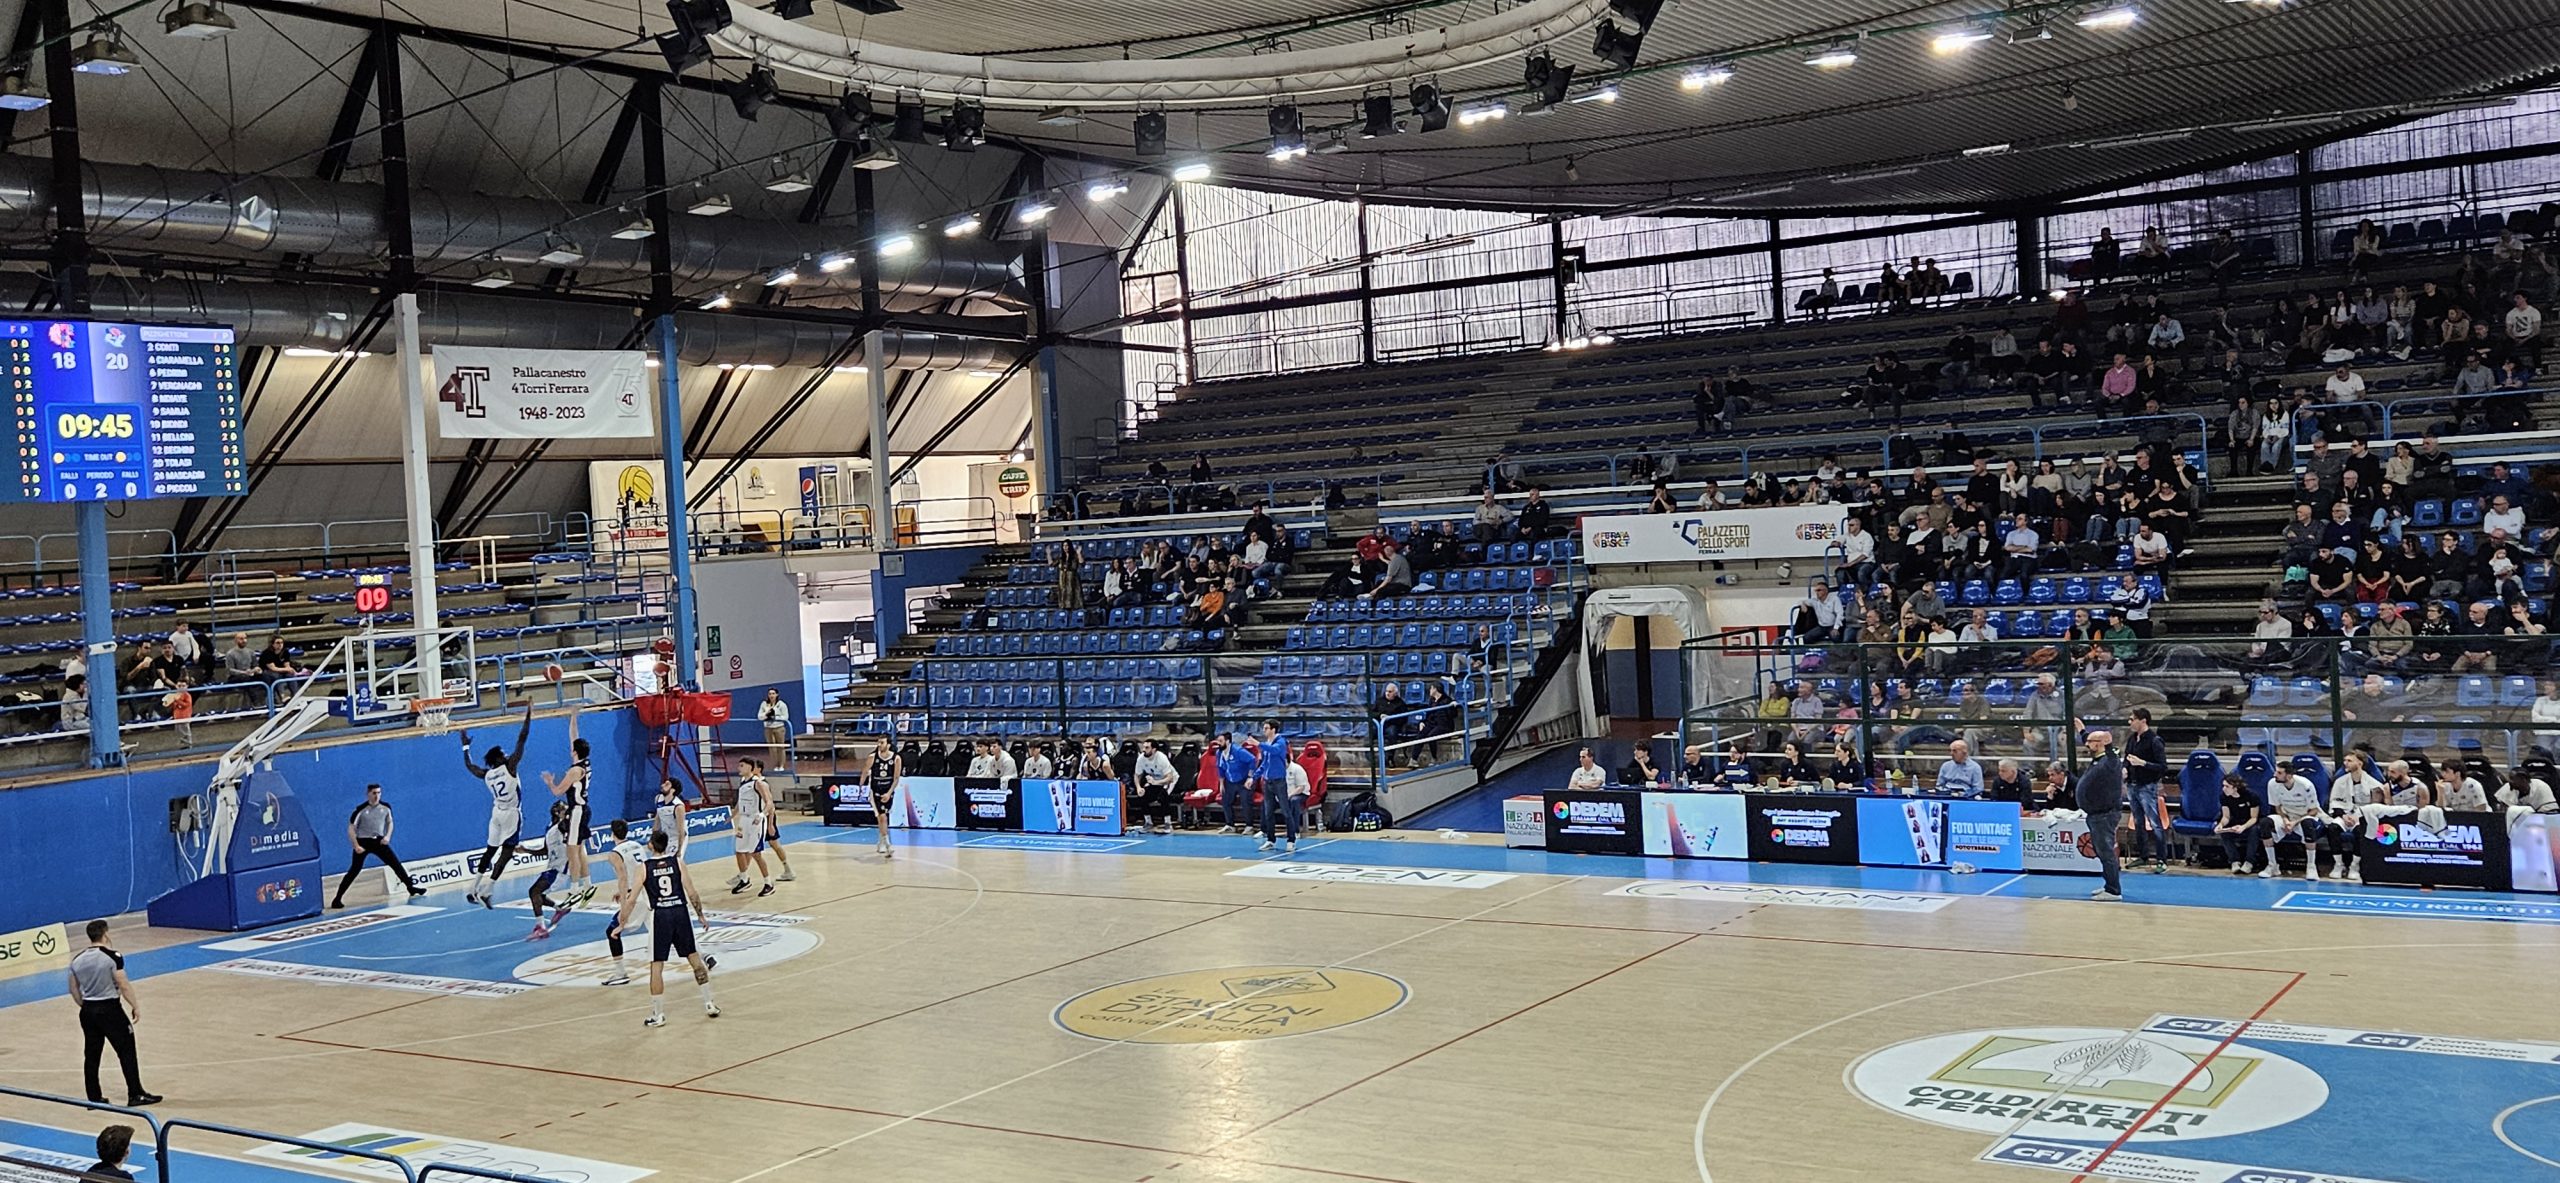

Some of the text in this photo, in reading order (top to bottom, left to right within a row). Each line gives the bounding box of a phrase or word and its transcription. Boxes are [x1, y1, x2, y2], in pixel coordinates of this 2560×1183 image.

[147, 343, 154, 351] 2
[52, 352, 76, 370] 18
[105, 352, 128, 370] 20
[148, 356, 155, 364] 4
[513, 367, 586, 378] Pallacanestro
[150, 381, 157, 390] 7
[511, 383, 589, 393] 4 Torri Ferrara
[152, 408, 159, 416] 9
[519, 406, 548, 419] 1948
[556, 406, 585, 419] 2023
[58, 414, 133, 438] 09:45
[151, 433, 161, 442] 11
[152, 446, 162, 454] 12
[84, 453, 113, 461] TIME OUT
[64, 482, 137, 499] 0 2 0
[155, 484, 166, 493] 42
[1698, 524, 1750, 537] PALAZZETTO
[1698, 536, 1750, 548] DELLO SPORT
[357, 588, 388, 611] 09
[492, 781, 508, 798] 12
[1570, 802, 1625, 817] DEDEM
[1506, 811, 1543, 823] LEGA
[1784, 829, 1829, 841] DEDEM
[1952, 822, 2012, 835] FOTO VINTAGE
[2399, 824, 2482, 844] DEEM
[250, 831, 299, 846] Dimedia
[2023, 830, 2073, 844] LEGA
[2023, 844, 2074, 852] NAZIONALE
[410, 866, 462, 885] Sanibol
[658, 876, 672, 896] 9
[1680, 885, 1946, 902] ADAMANT
[1128, 994, 1323, 1016] STAGIONI
[1101, 1002, 1291, 1027] D'ITALIA
[2168, 1020, 2212, 1030] CFI
[2362, 1036, 2409, 1046] CFI
[2429, 1038, 2486, 1046] Centro
[1908, 1086, 2208, 1126] COLDIRETTI
[1904, 1098, 2178, 1136] FERRARA
[2013, 1147, 2066, 1160] CFI
